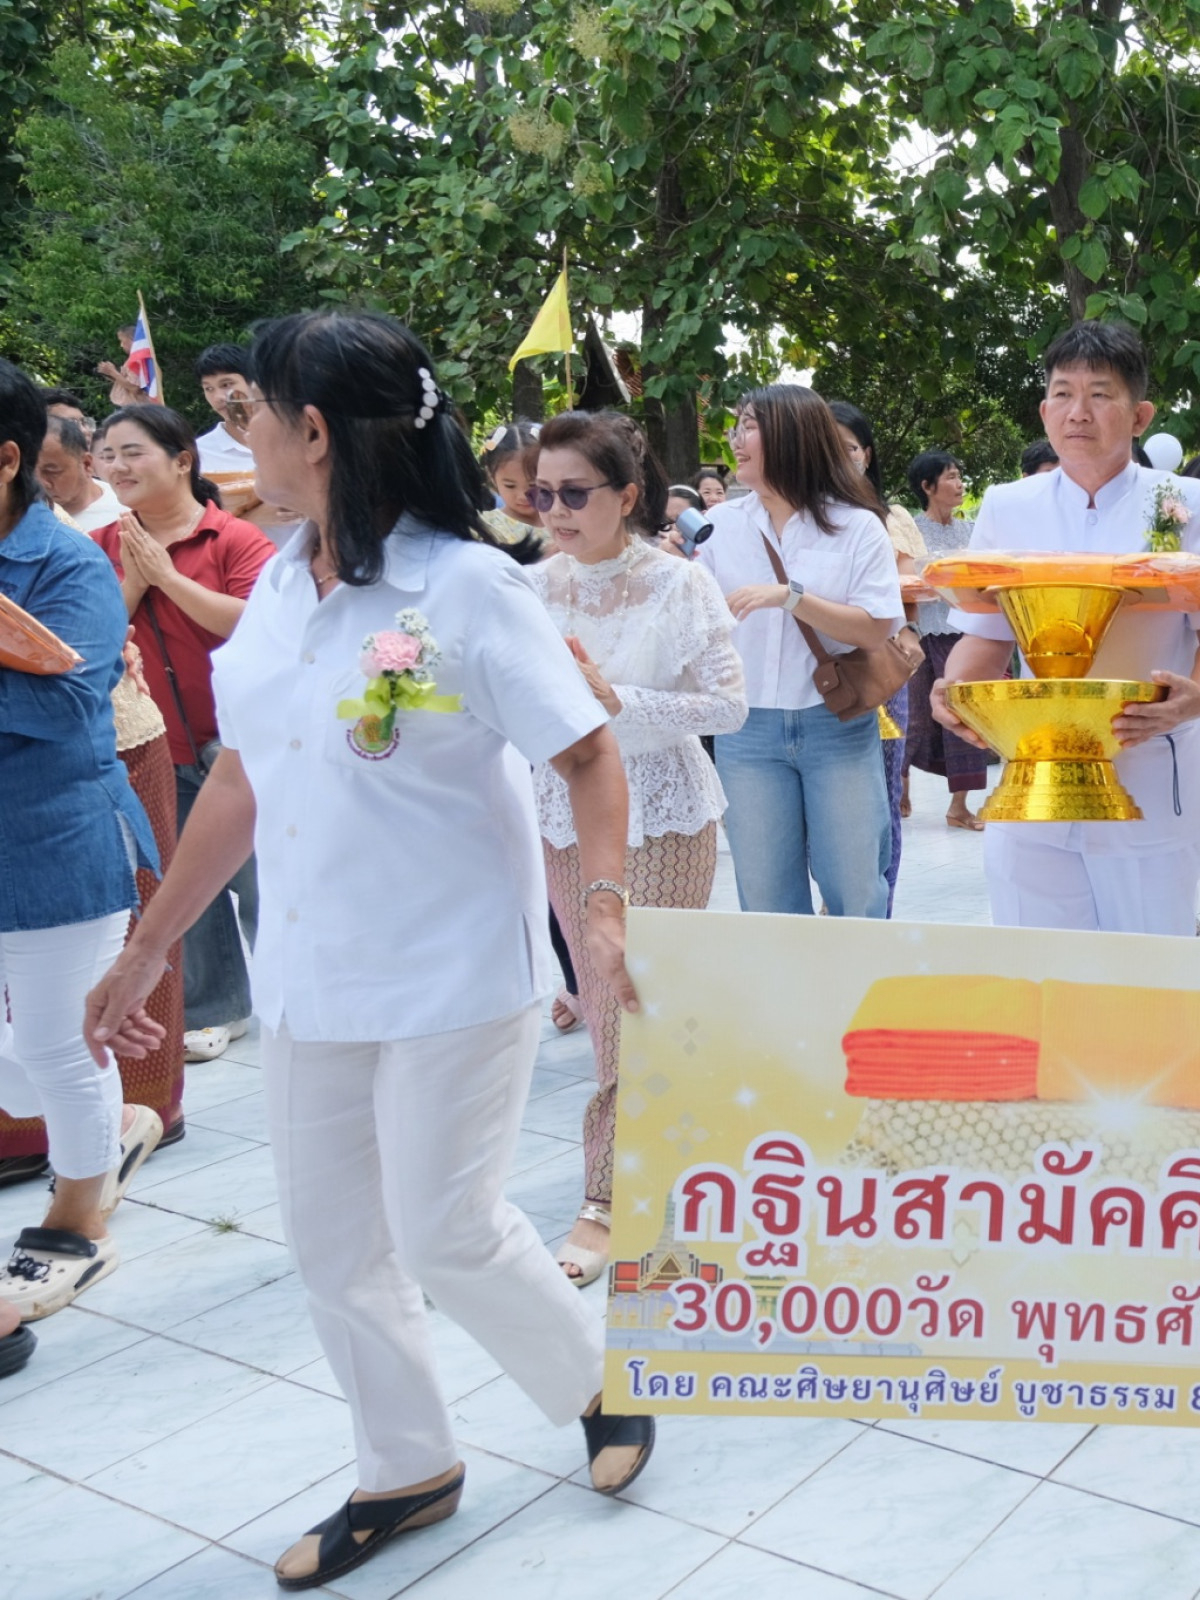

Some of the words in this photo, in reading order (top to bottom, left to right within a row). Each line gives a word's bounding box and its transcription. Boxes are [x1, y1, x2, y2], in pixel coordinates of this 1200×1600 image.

[673, 1275, 984, 1344] 30,000วัด
[628, 1361, 694, 1397] โดย
[711, 1366, 1001, 1413] คณะศิษยานุศิษย์
[1015, 1380, 1175, 1416] บูชาธรรม
